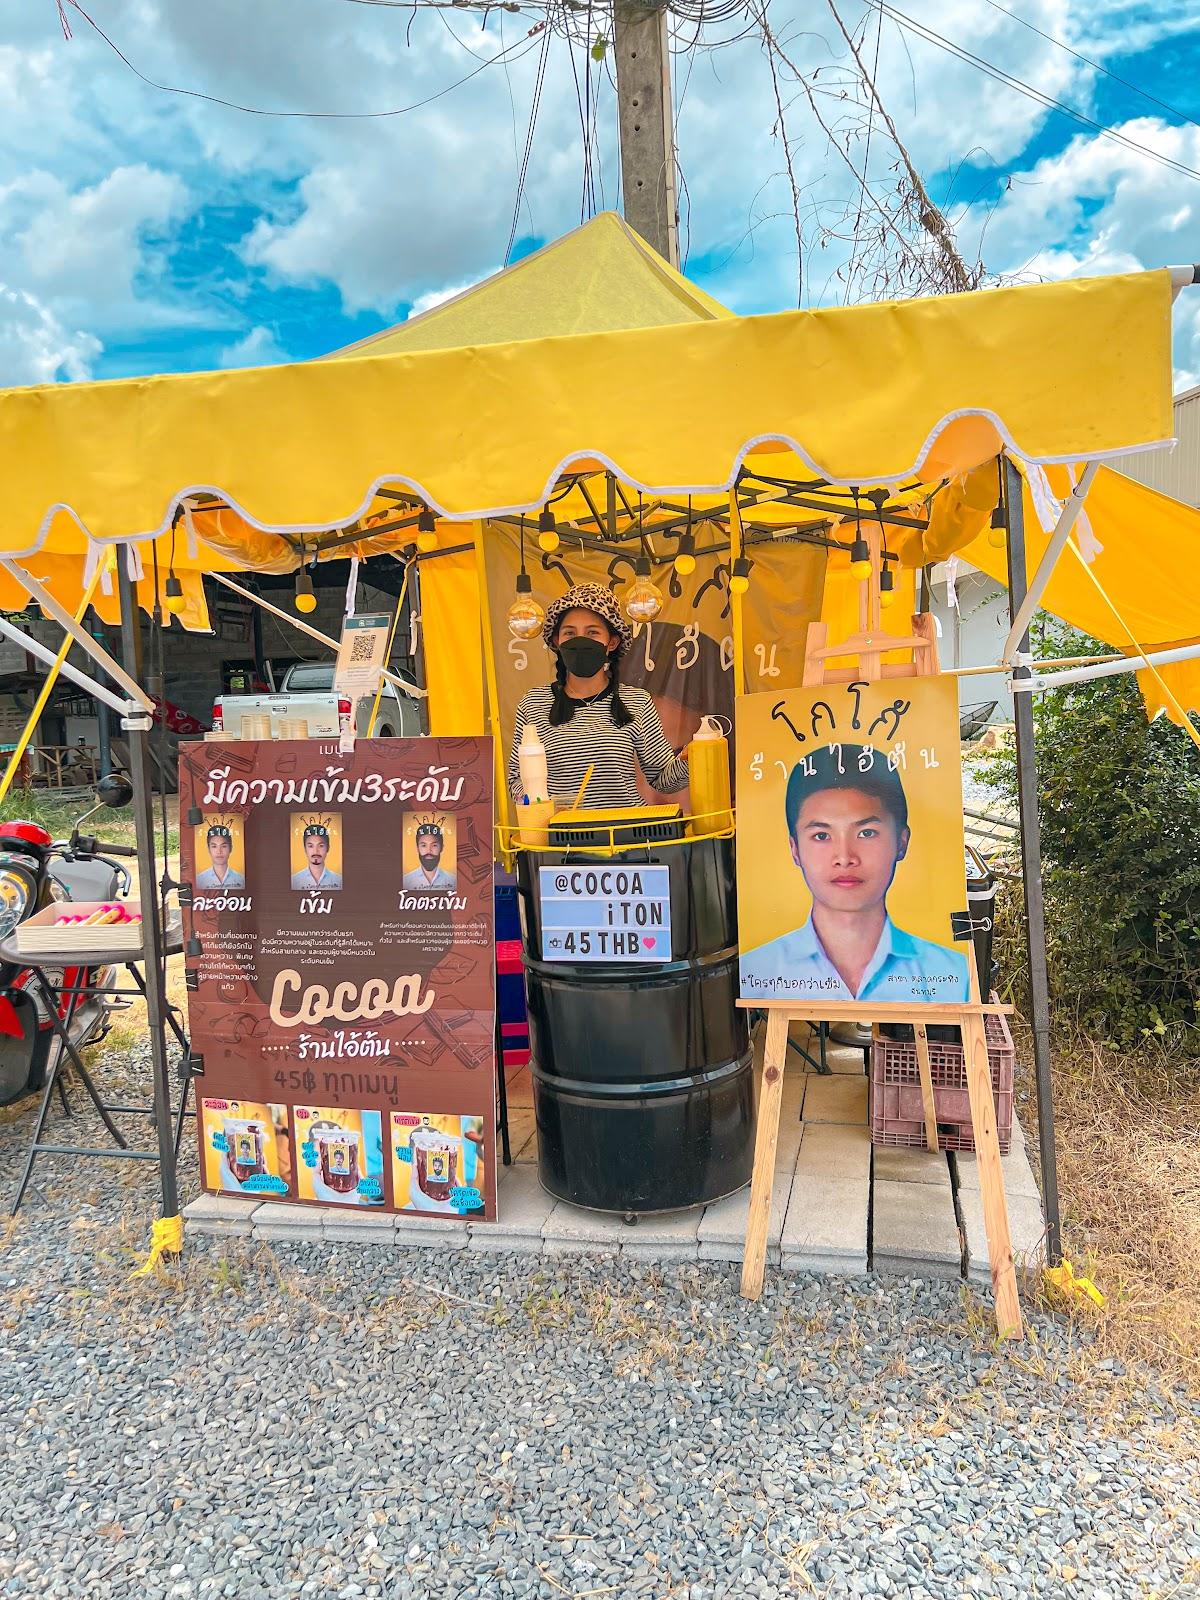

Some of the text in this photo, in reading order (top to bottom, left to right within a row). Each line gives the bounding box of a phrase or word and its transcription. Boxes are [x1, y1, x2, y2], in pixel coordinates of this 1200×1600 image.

[772, 682, 911, 742] โกโก้
[750, 740, 940, 782] ร้านไอ้ต้น
[204, 766, 464, 804] มีความเข้ม3ระดับ
[555, 872, 643, 895] @COCOA
[192, 890, 252, 911] ละอ่อน
[300, 890, 332, 914] เข้ม
[398, 890, 467, 910] โคตรเข้ม
[270, 968, 435, 1027] Cocoa
[298, 1031, 390, 1058] ร้านไอ้ต้น
[322, 1072, 398, 1105] ทุกเมนู
